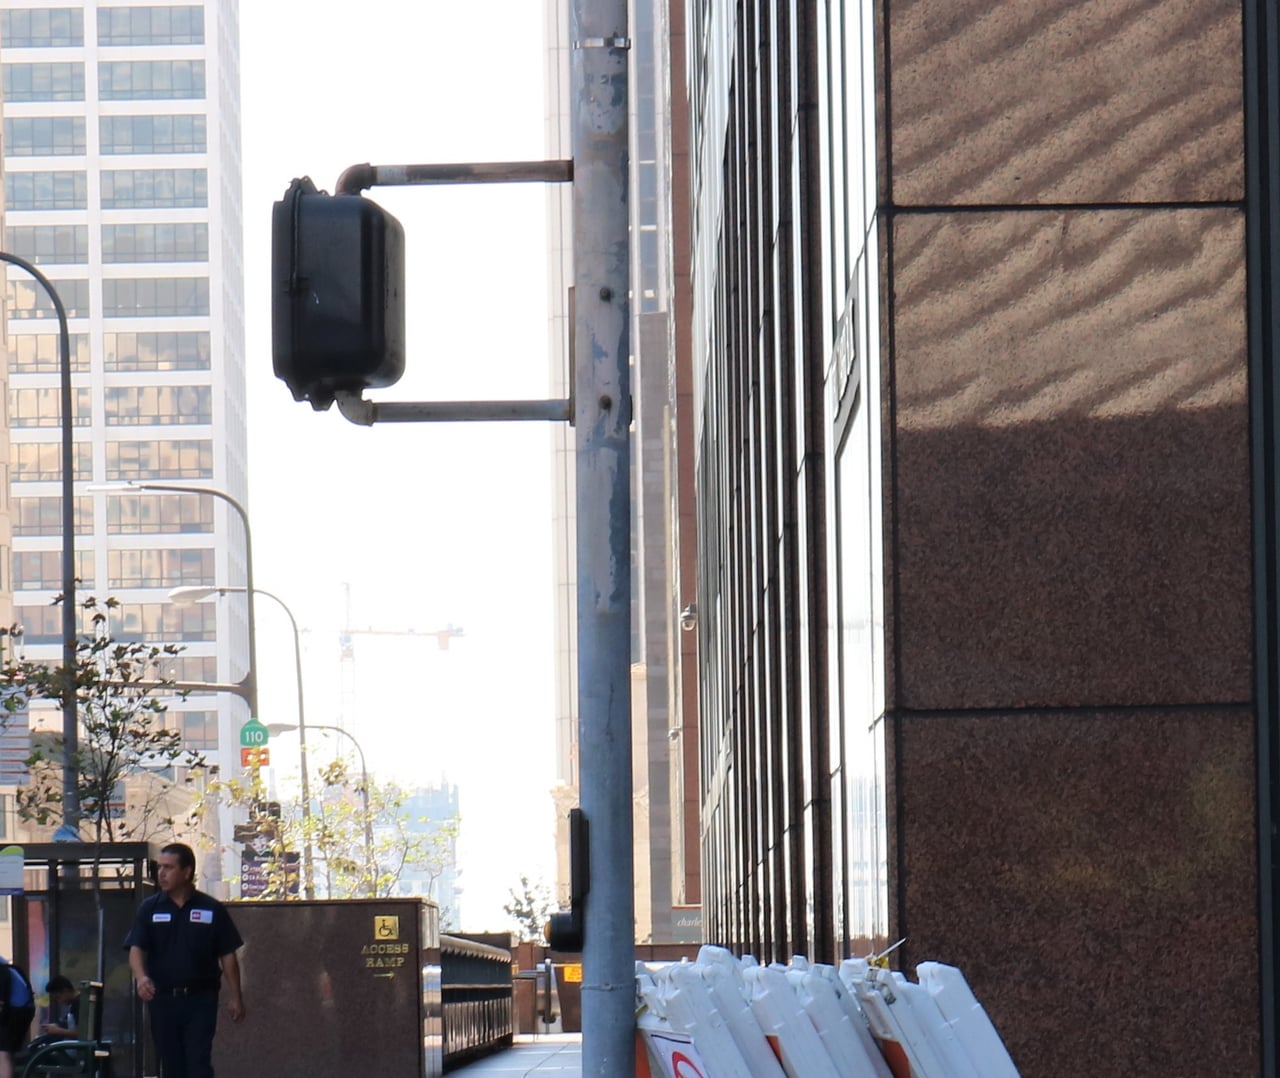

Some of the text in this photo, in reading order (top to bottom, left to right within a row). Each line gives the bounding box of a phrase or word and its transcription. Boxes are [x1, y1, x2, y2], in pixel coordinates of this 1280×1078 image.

[245, 730, 264, 743] 110
[361, 943, 410, 955] ACCESS
[365, 957, 406, 968] RAMP
